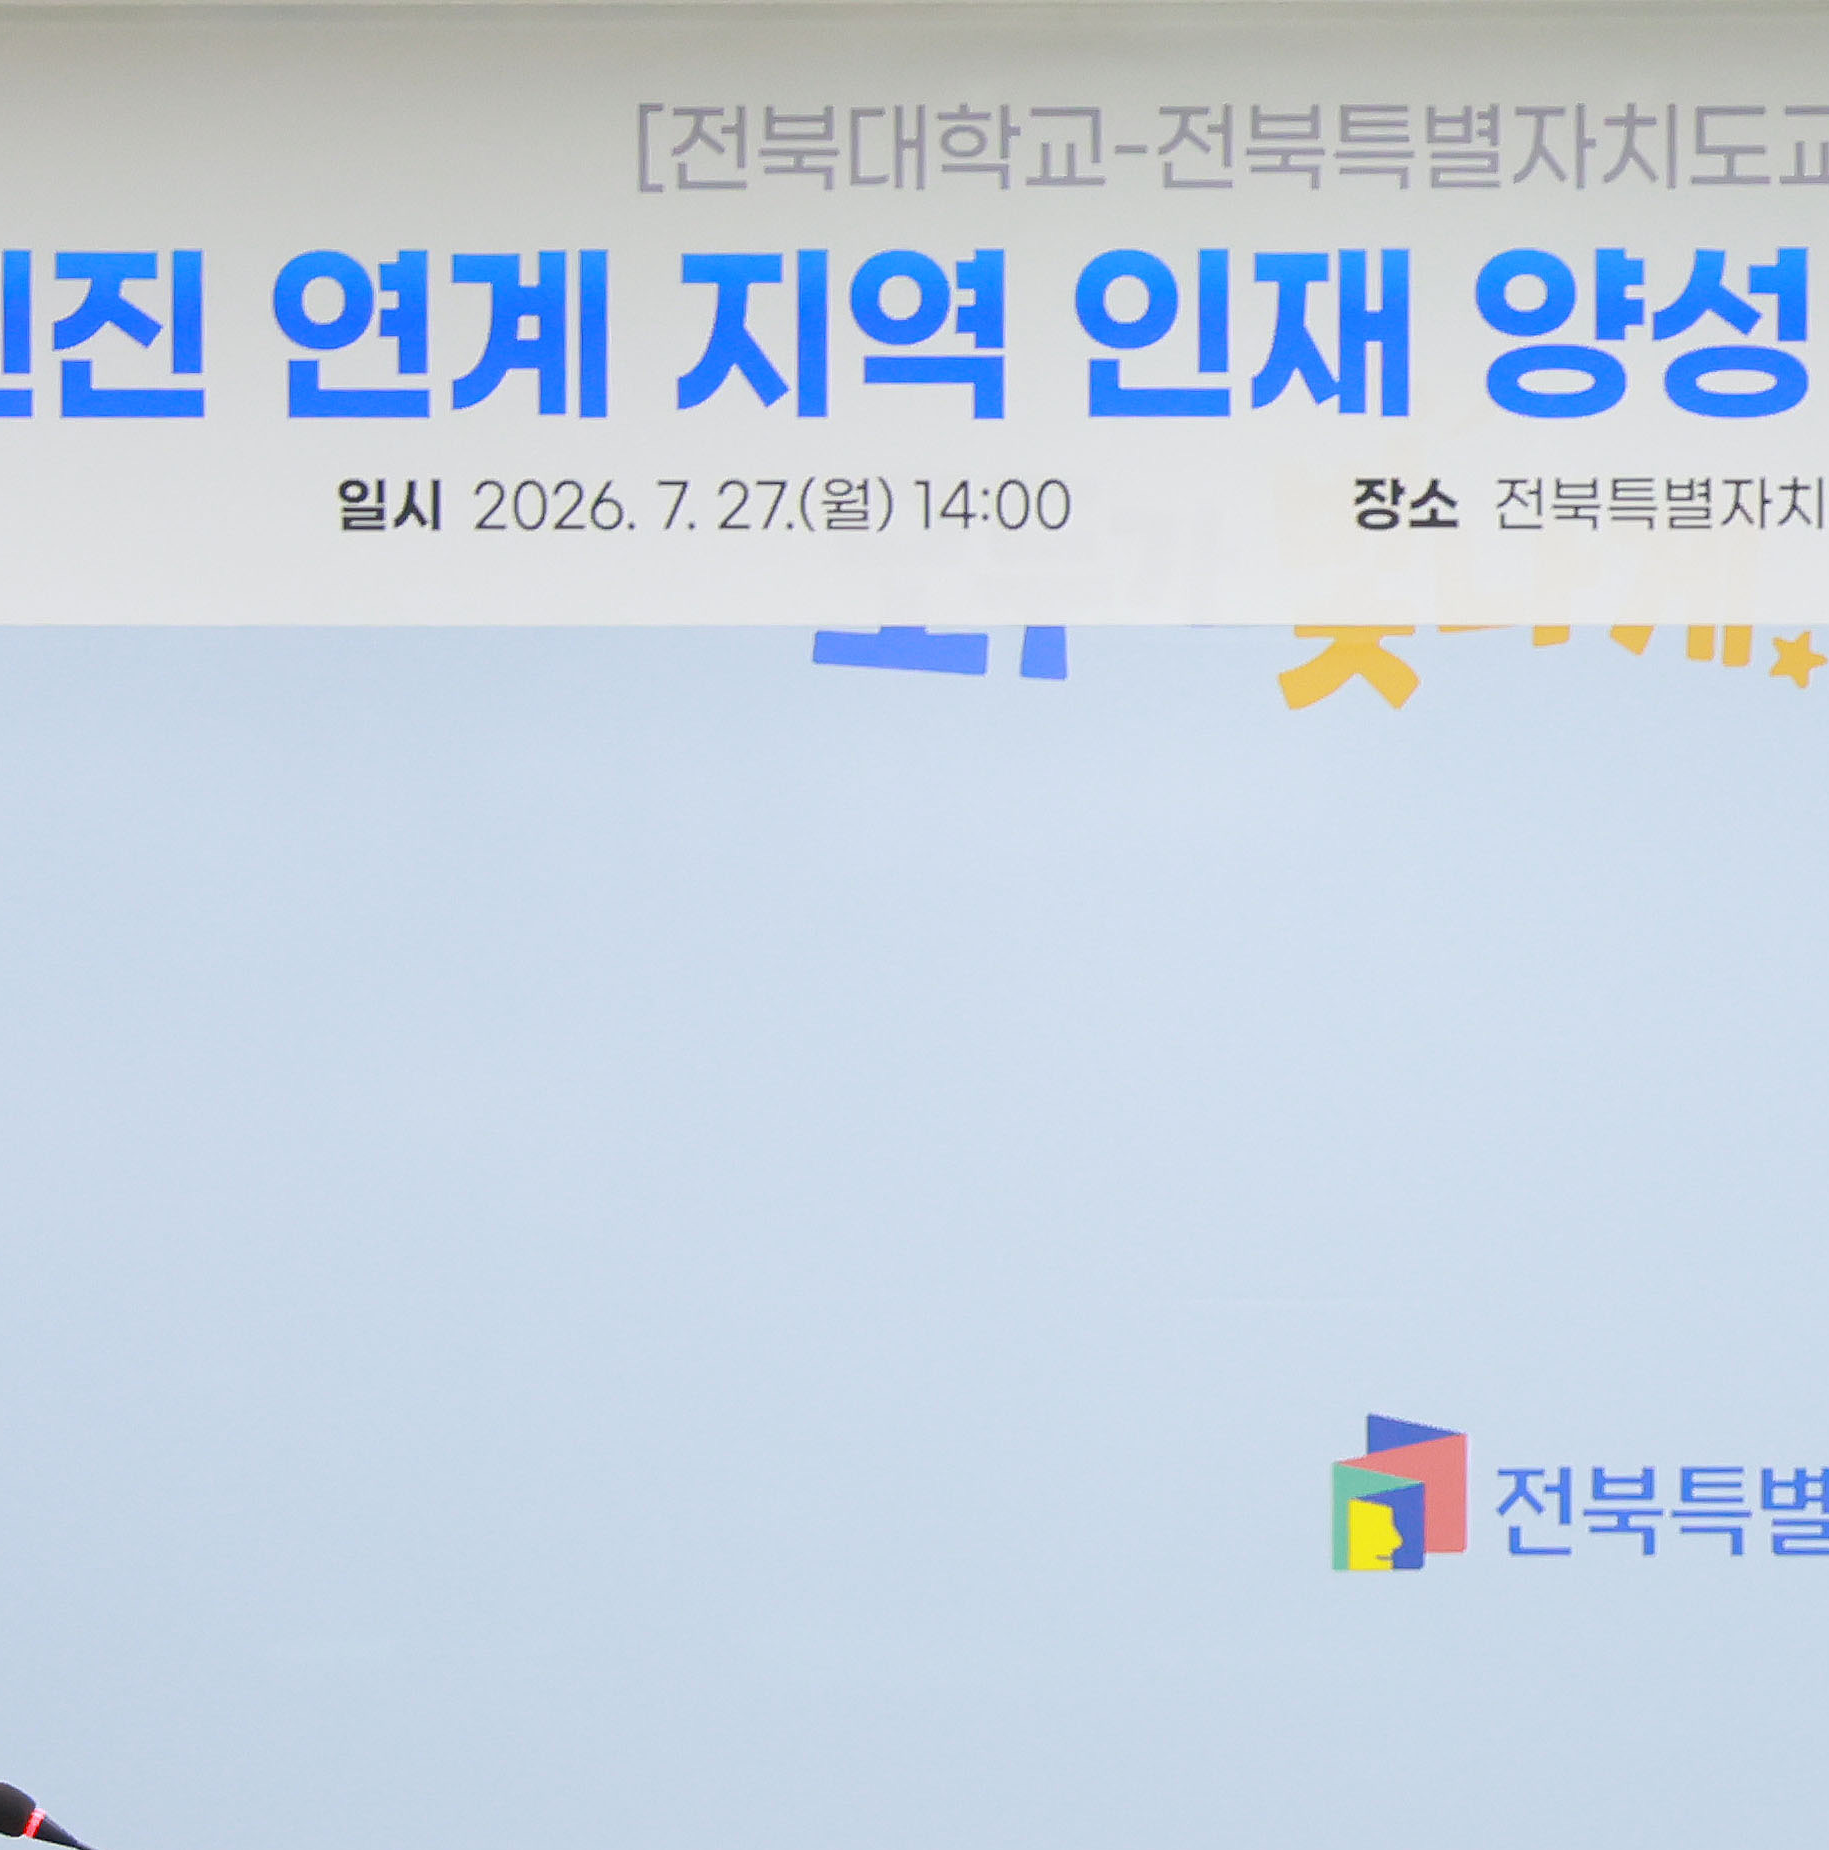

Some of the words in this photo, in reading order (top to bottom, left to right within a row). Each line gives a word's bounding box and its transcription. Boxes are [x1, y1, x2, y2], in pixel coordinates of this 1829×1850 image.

[273, 249, 610, 420] 연계
[677, 249, 1007, 421] 지역
[1075, 248, 1412, 419] 인재
[1475, 247, 1811, 420] 양성
[338, 479, 442, 533] 일시
[475, 480, 636, 532] 2026.
[658, 481, 697, 531] 7.
[719, 478, 894, 533] 27.(월)
[915, 480, 1072, 531] 14:00
[1355, 478, 1460, 532] 장소
